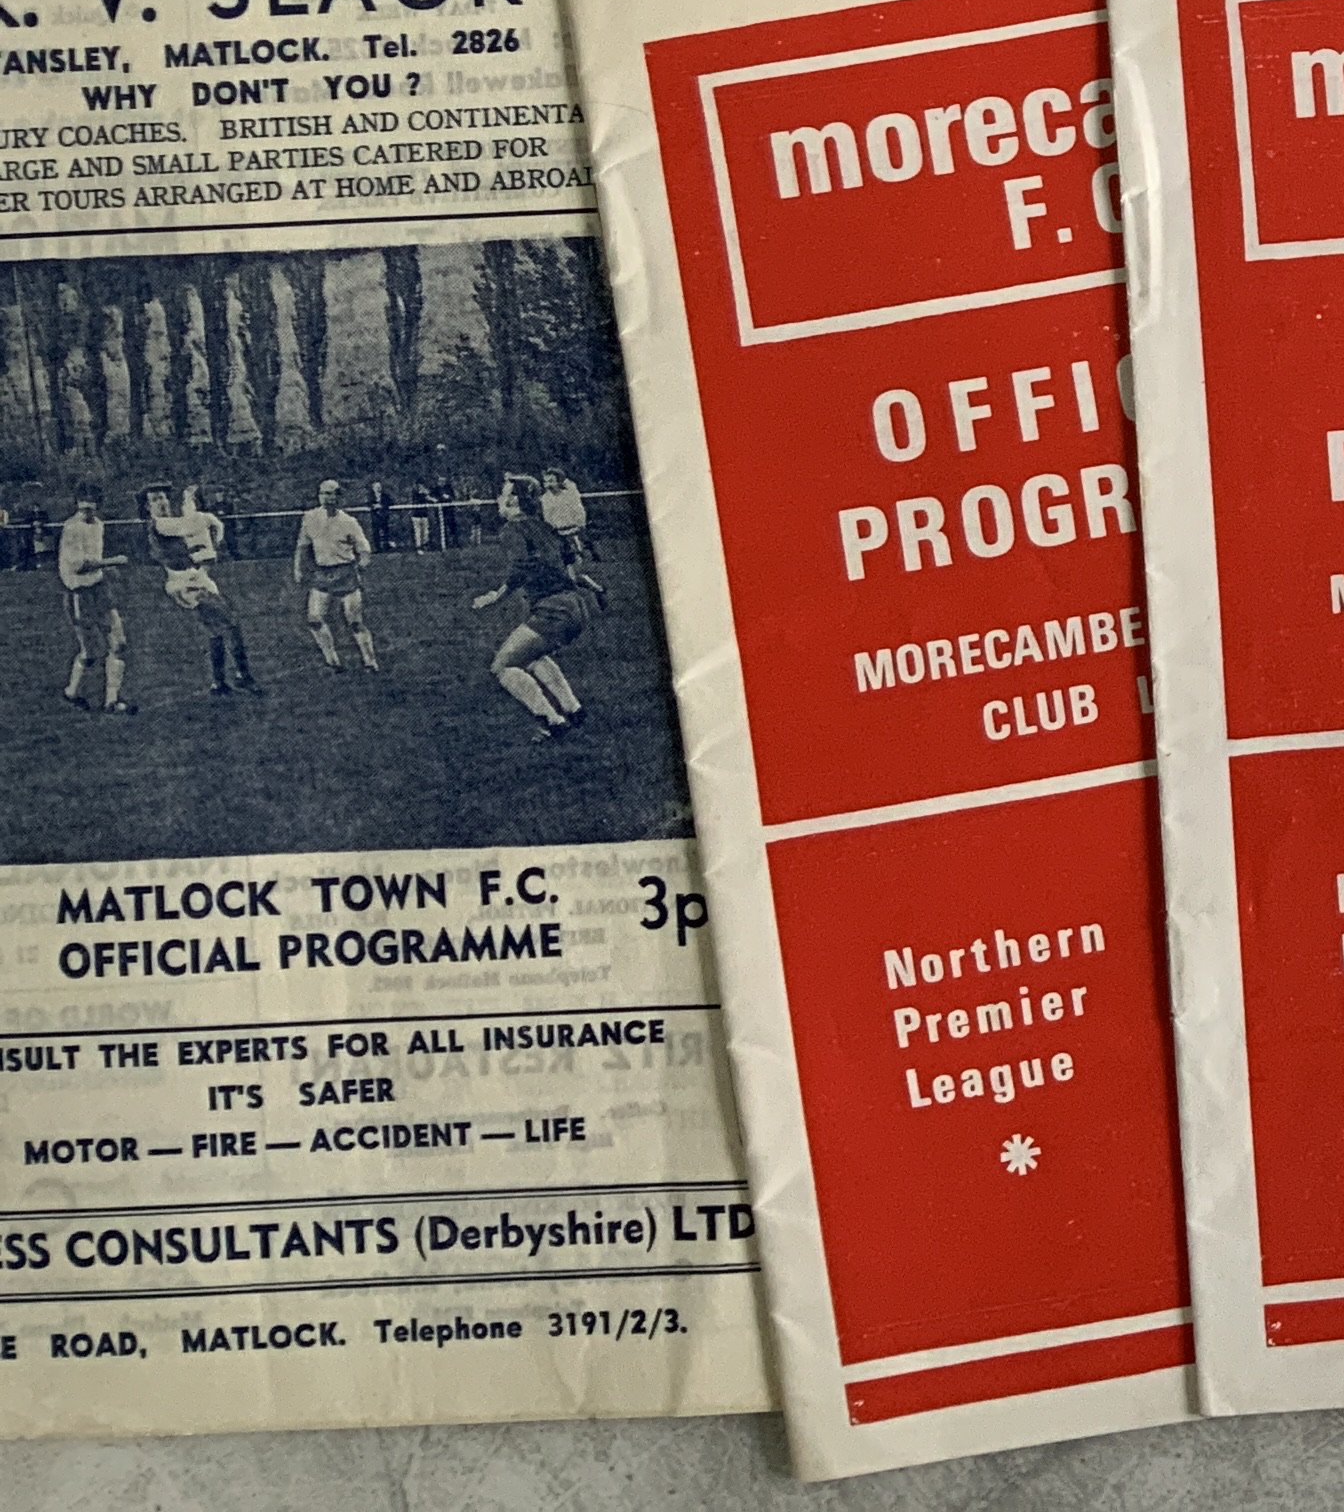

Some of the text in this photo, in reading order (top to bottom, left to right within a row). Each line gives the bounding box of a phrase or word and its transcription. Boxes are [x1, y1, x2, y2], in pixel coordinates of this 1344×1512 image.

[165, 28, 520, 68] MATLOCK. Tel. 2826
[82, 84, 156, 110] WHY
[192, 78, 289, 106] DON'T
[68, 137, 548, 178] AND SMALL PARTIES CATERED FOR
[853, 605, 1144, 692] MORECAMBE
[983, 685, 1098, 740] CLUB
[57, 867, 712, 950] MATLOCK TOWN F.C. 3p
[59, 923, 562, 979] OFFICIAL PROGRAMME
[98, 1020, 664, 1068] THE EXPERTS FOR ALL INSURANCE
[209, 1078, 395, 1110] IT'S SAFER
[25, 1117, 585, 1165] MOTOR FIRE ACCIDENT LIFE
[66, 1217, 399, 1267] CONSULTANTS
[415, 1207, 656, 1261] (Derbyshire)
[51, 1308, 687, 1358] ROAD, MATLOCK. Telephone 3191/2/3.
